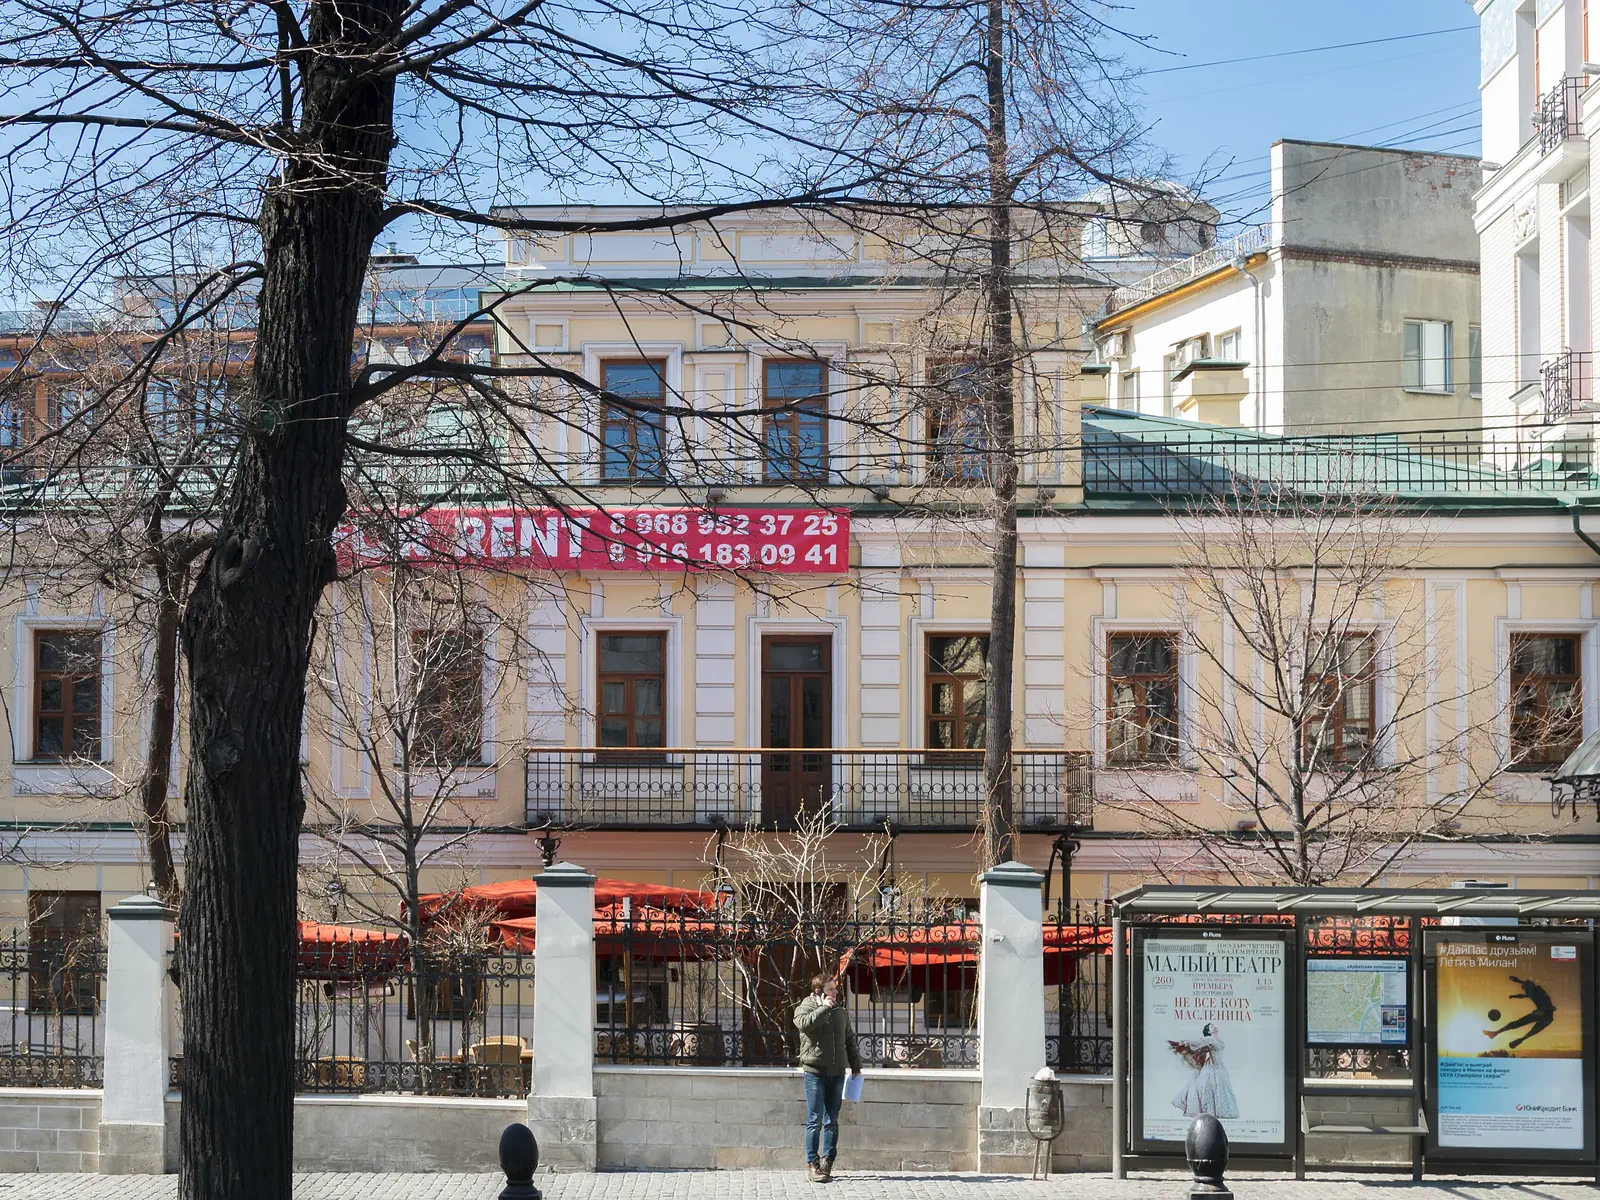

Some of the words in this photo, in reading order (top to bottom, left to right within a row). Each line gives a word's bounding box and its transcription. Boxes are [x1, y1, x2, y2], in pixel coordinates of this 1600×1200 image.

[609, 513, 626, 535] 8
[635, 513, 689, 535] 968
[697, 514, 750, 536] 952
[759, 514, 795, 536] 37
[803, 514, 838, 536] 25
[454, 516, 590, 558] RENT
[635, 543, 689, 564] 916
[699, 544, 750, 565] 183
[760, 543, 795, 565] 09
[804, 544, 838, 565] 41
[1439, 944, 1487, 955] #ДайПас
[1489, 946, 1537, 956] друзьям!
[1145, 952, 1217, 972] МАЛЫЙ
[1221, 956, 1282, 973] ТЕАТР
[1439, 957, 1466, 967] Лети
[1469, 959, 1476, 967] в
[1478, 957, 1517, 968] Милан!
[1155, 976, 1172, 985] 260
[1192, 982, 1233, 990] ПРЕМЬЕРА
[1174, 997, 1190, 1008] НЕ
[1194, 998, 1217, 1008] ВСЕ
[1221, 998, 1252, 1009] КОТУ
[1174, 1009, 1252, 1022] МАСЛЕНИЦА
[1523, 1104, 1561, 1112] ЮниКредит
